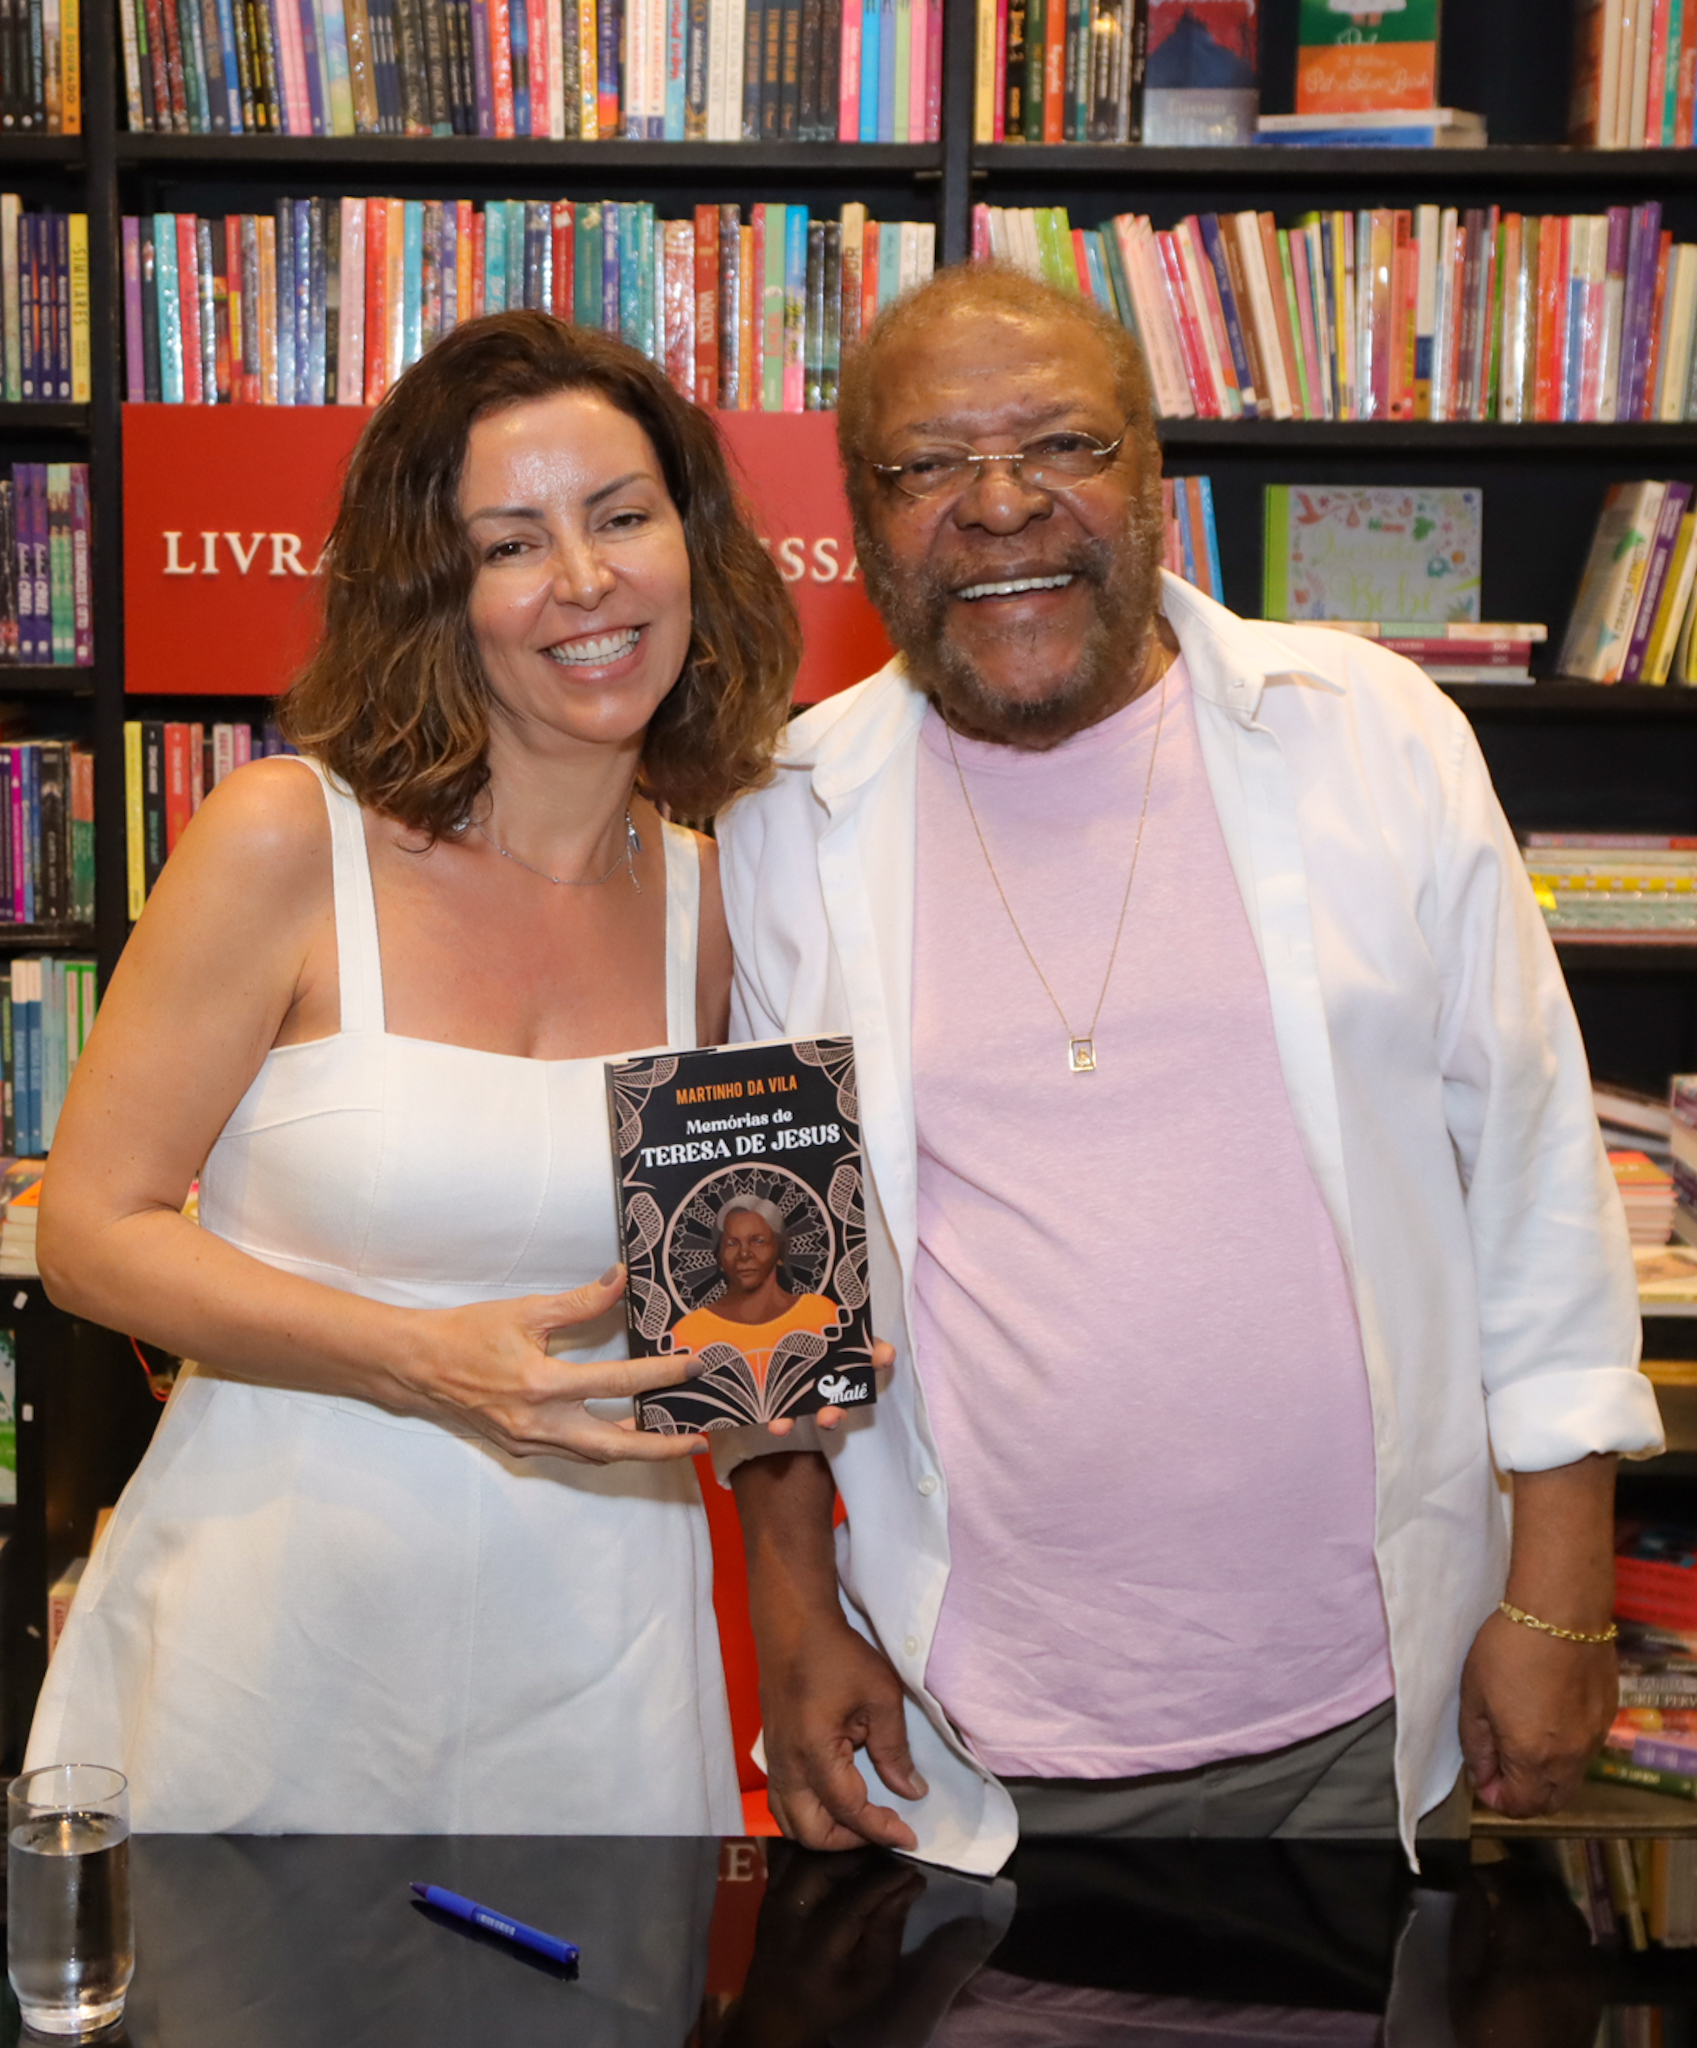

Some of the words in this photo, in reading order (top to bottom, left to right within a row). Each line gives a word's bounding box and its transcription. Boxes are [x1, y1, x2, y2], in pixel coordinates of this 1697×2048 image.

[73, 247, 87, 327] SIMILARES
[675, 1081, 744, 1105] MARTINHO
[748, 1079, 765, 1097] DA
[768, 1074, 798, 1093] VILA
[686, 1112, 769, 1135] Memórias
[772, 1108, 793, 1124] de
[640, 1136, 731, 1168] TERESA
[735, 1133, 766, 1156] DE
[771, 1123, 840, 1151] JESUS
[827, 1382, 869, 1405] malê
